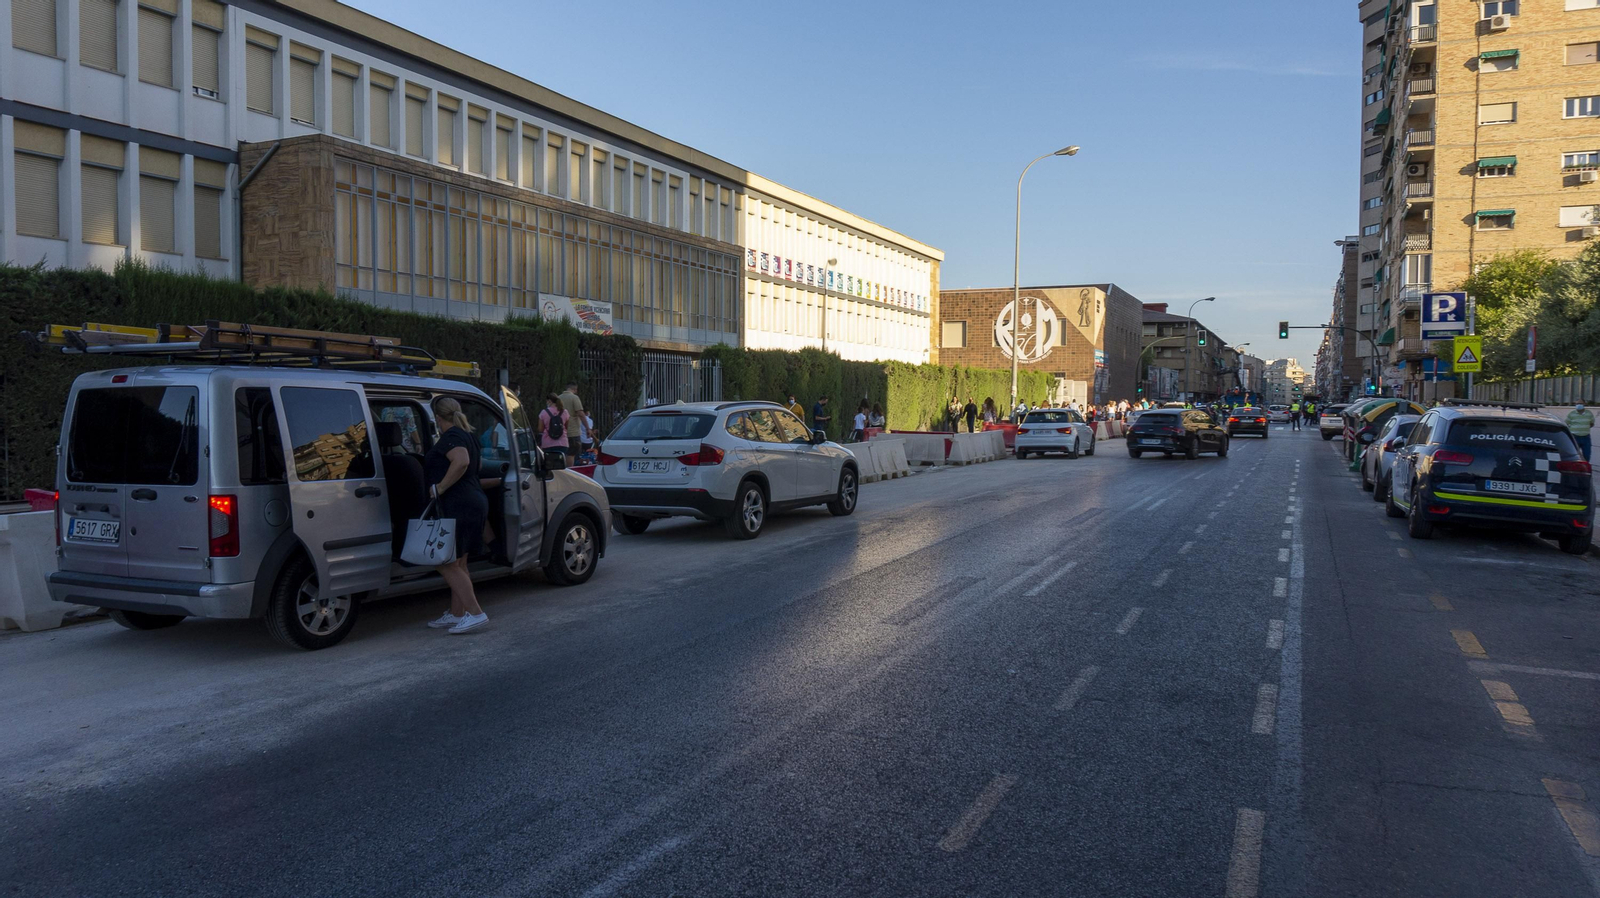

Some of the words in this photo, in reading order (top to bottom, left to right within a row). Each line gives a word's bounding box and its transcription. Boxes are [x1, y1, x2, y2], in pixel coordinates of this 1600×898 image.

[1431, 295, 1457, 321] P
[1470, 433, 1516, 442] POLICÍA
[1518, 436, 1556, 446] LOCAL
[632, 461, 650, 471] 6127
[653, 461, 667, 471] HCJ
[1491, 480, 1515, 491] 9391
[1519, 483, 1538, 493] JXG
[75, 520, 98, 536] 5617
[100, 522, 119, 538] GRX
